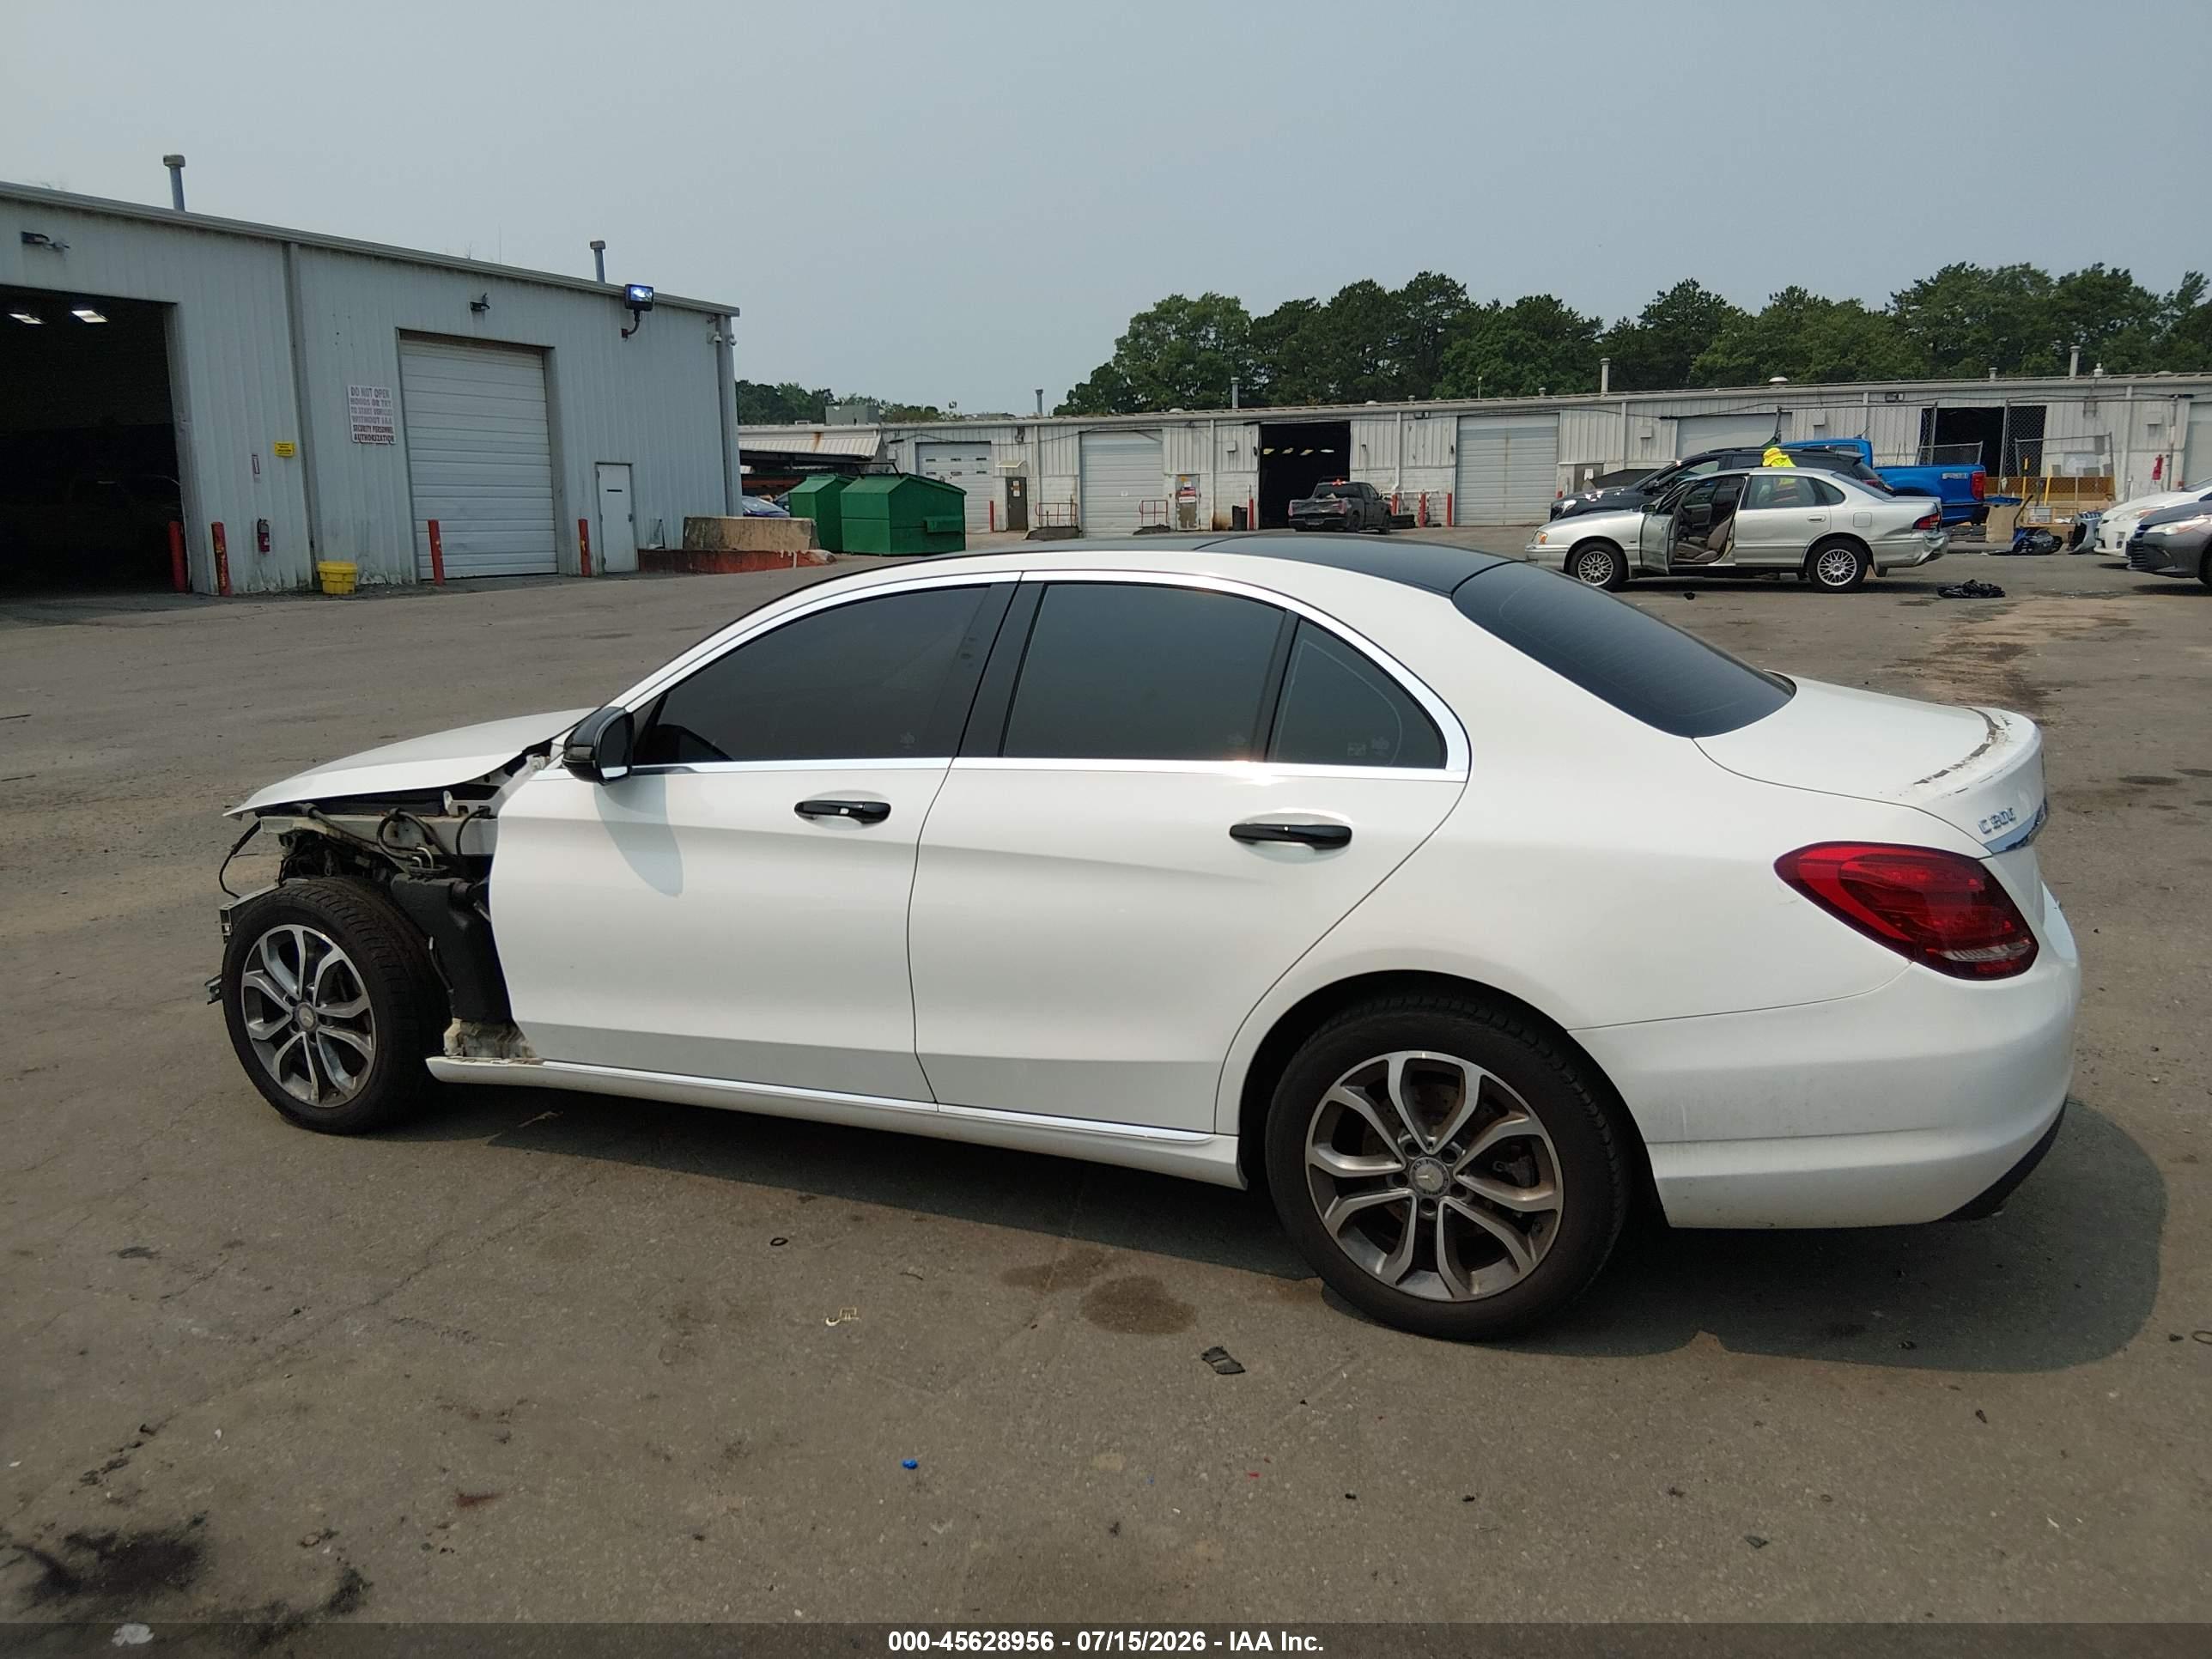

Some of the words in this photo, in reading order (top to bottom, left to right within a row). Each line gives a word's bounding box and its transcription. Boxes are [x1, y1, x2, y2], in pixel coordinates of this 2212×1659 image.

[350, 386, 360, 396] DO
[361, 387, 373, 398] NOT
[374, 388, 391, 398] OPEN
[372, 398, 380, 407] OR
[380, 399, 392, 408] TRY
[353, 424, 372, 433] SECURITY
[354, 433, 395, 442] AUTHORIZATION
